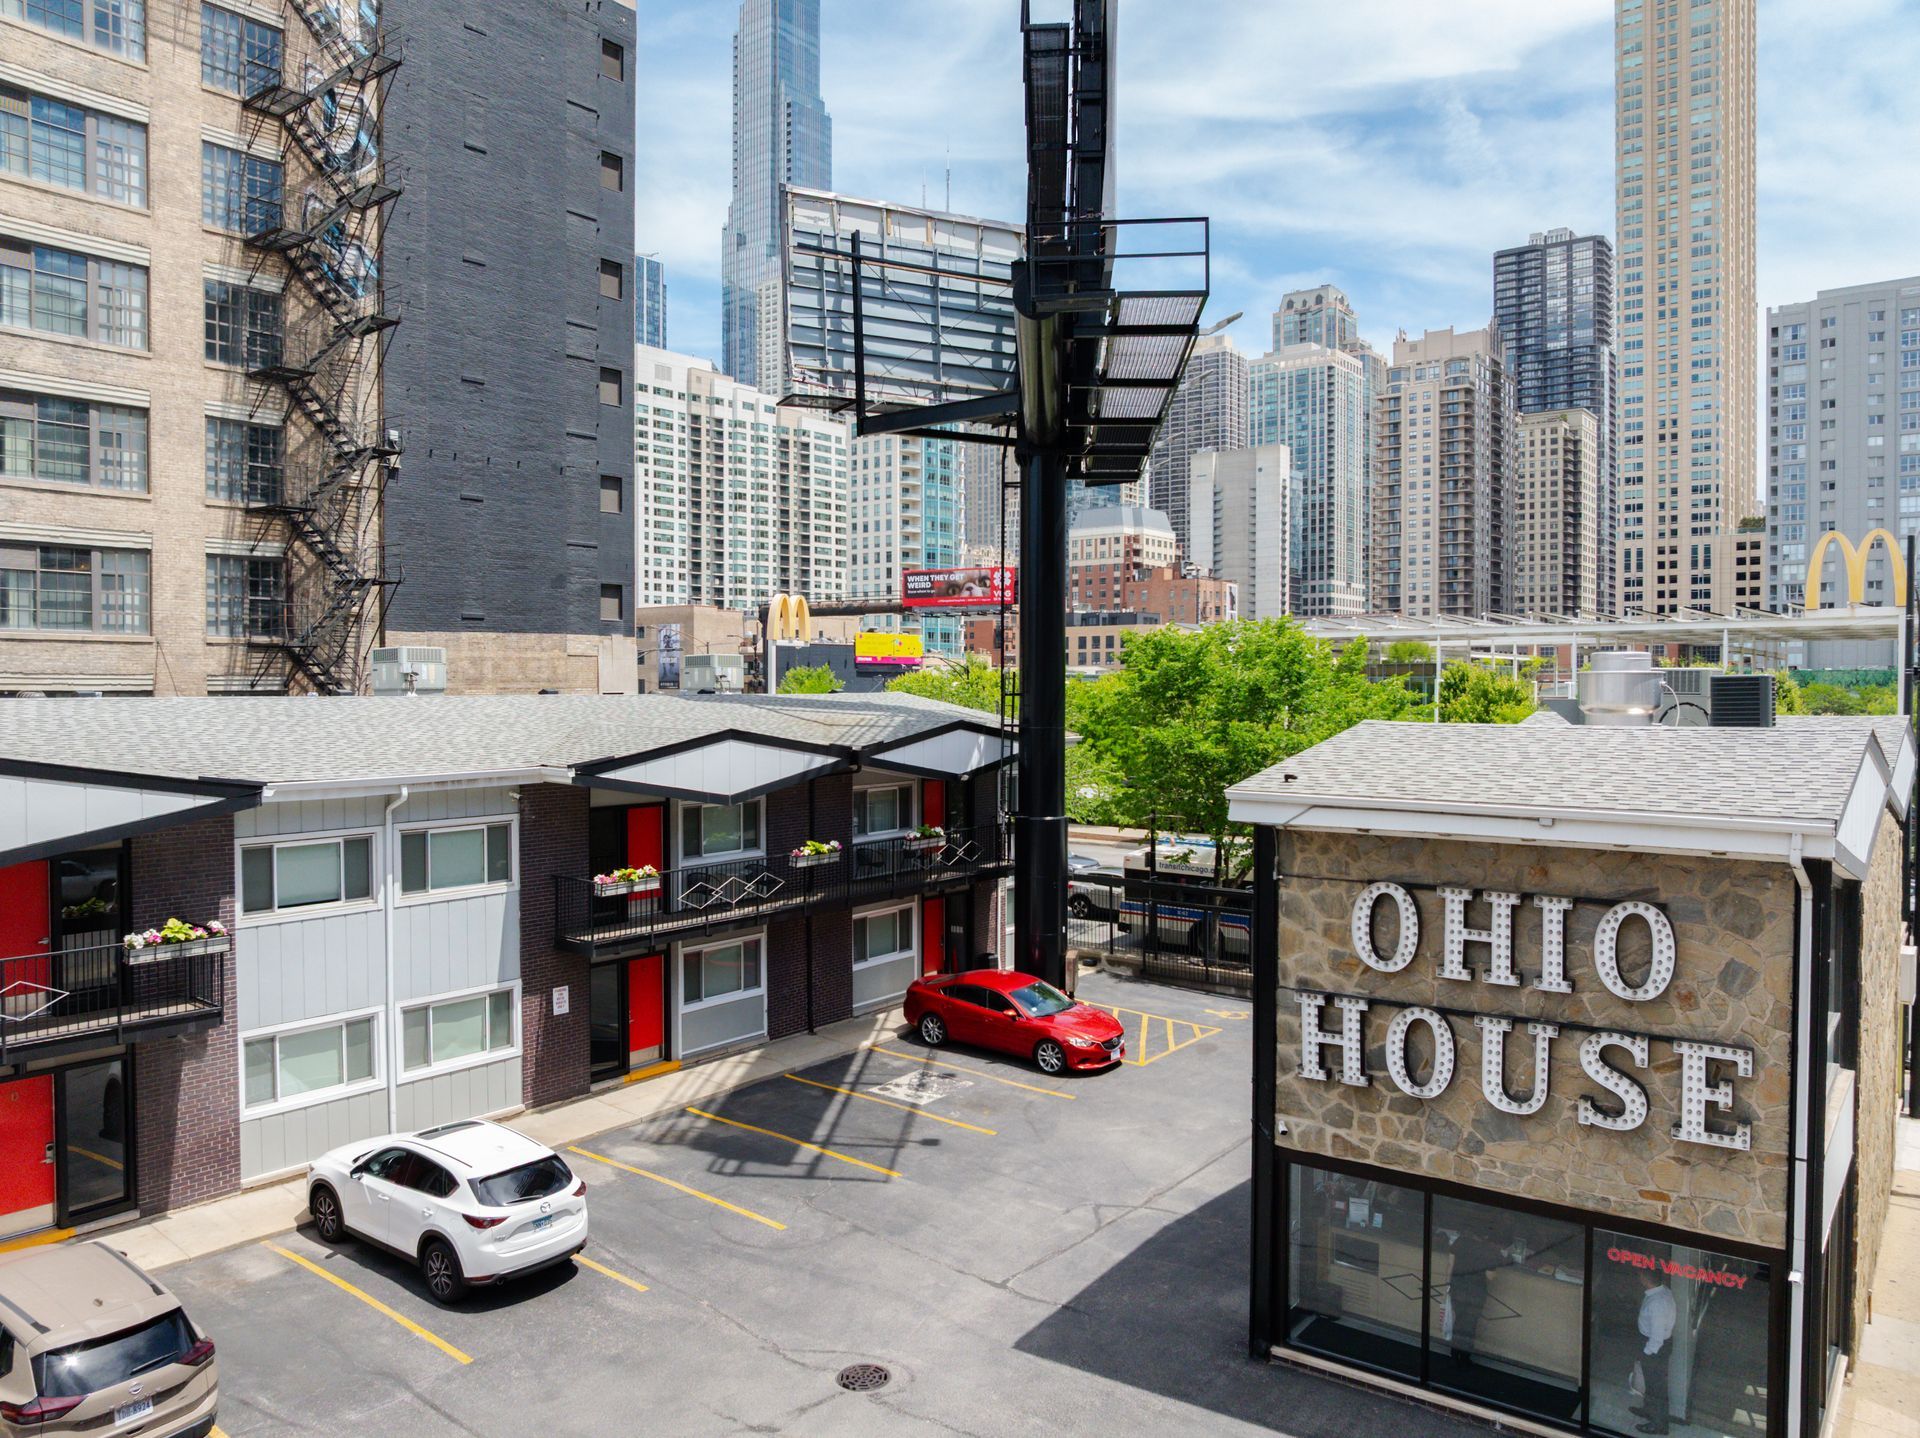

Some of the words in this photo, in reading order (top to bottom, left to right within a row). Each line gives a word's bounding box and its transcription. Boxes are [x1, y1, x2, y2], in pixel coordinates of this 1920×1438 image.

[1351, 881, 1677, 1002] OHIO
[1295, 991, 1753, 1151] HOUSE
[1607, 1247, 1656, 1271] OPEN
[1659, 1257, 1748, 1290] VACANCY
